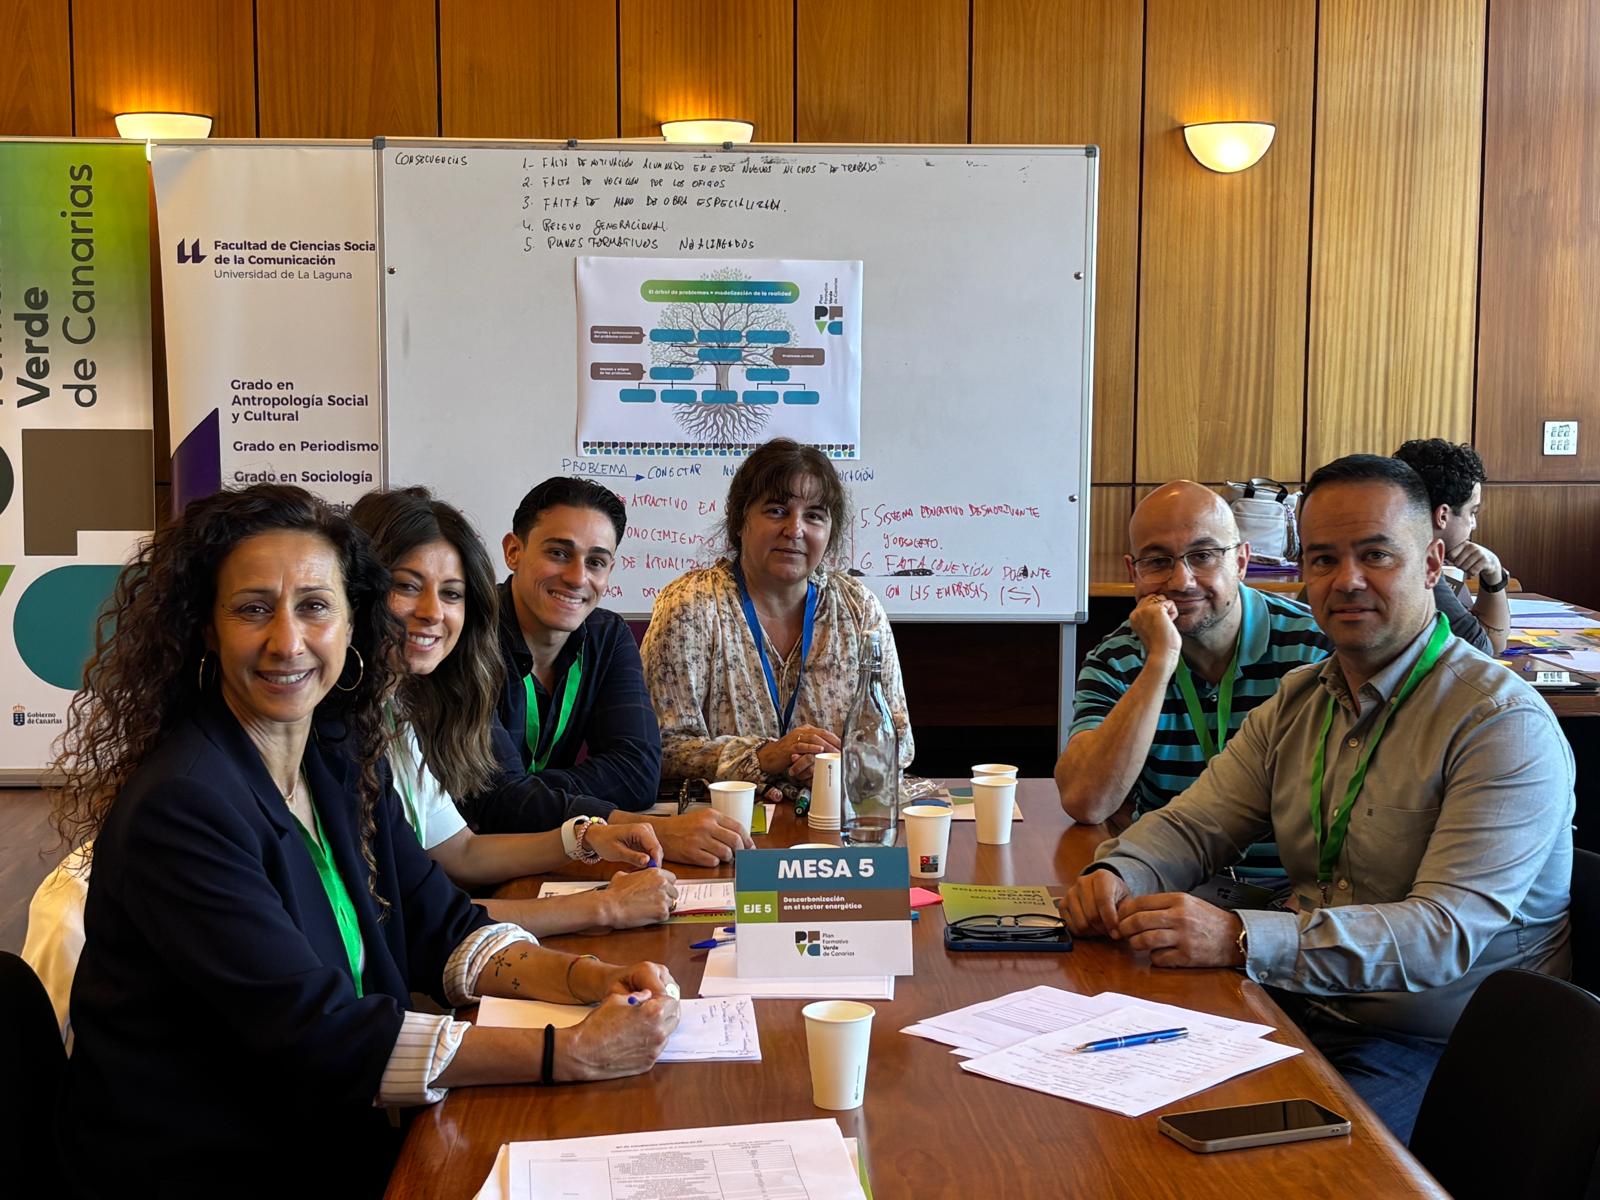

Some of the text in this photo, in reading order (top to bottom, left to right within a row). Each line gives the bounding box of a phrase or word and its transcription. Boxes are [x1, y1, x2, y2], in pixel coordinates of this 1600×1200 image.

[214, 240, 376, 251] Facultad de Ciencias Socia
[214, 254, 336, 265] de la Comunicación
[214, 270, 352, 281] Universidad de La Laguna
[60, 163, 97, 408] de Canarias
[13, 287, 50, 408] Verde
[231, 379, 294, 391] Grado en
[231, 394, 368, 408] Antropología Social
[231, 410, 299, 423] y Cultural
[233, 440, 379, 452] Grado en Periodismo
[562, 458, 628, 477] PROBLEMA
[648, 463, 702, 480] CONECTAR
[234, 470, 373, 484] Grado en Sociología
[632, 493, 688, 510] ATRACTIVO
[699, 501, 716, 515] EN
[627, 526, 715, 547] ONOCIMIENTO
[621, 555, 636, 570] DE
[778, 858, 874, 879] MESA 5
[743, 904, 772, 914] EJE 5
[825, 903, 862, 911] energético
